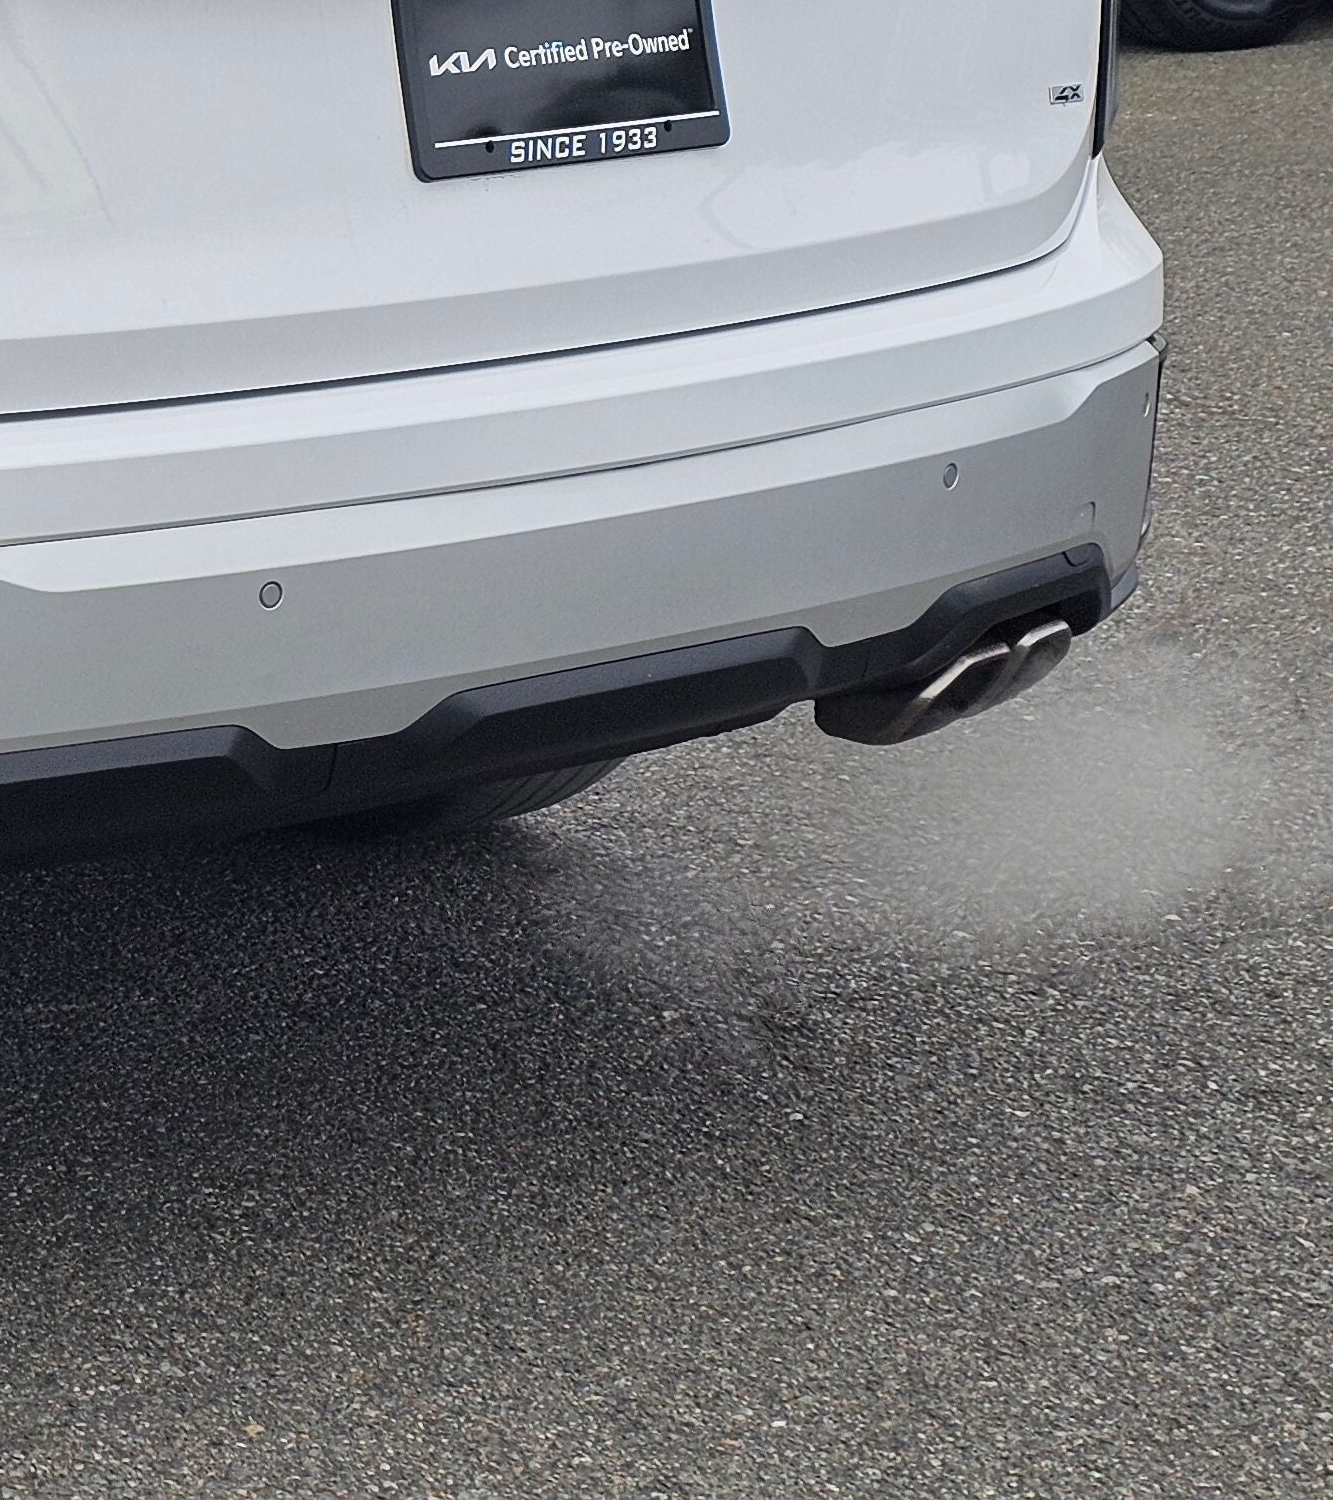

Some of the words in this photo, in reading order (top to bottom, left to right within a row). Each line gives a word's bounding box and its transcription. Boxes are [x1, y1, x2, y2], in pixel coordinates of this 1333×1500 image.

[429, 48, 497, 76] KIA
[504, 39, 589, 68] Certified
[591, 28, 690, 60] Pre-Owned
[510, 135, 586, 163] SINCE
[599, 126, 658, 153] 1933
